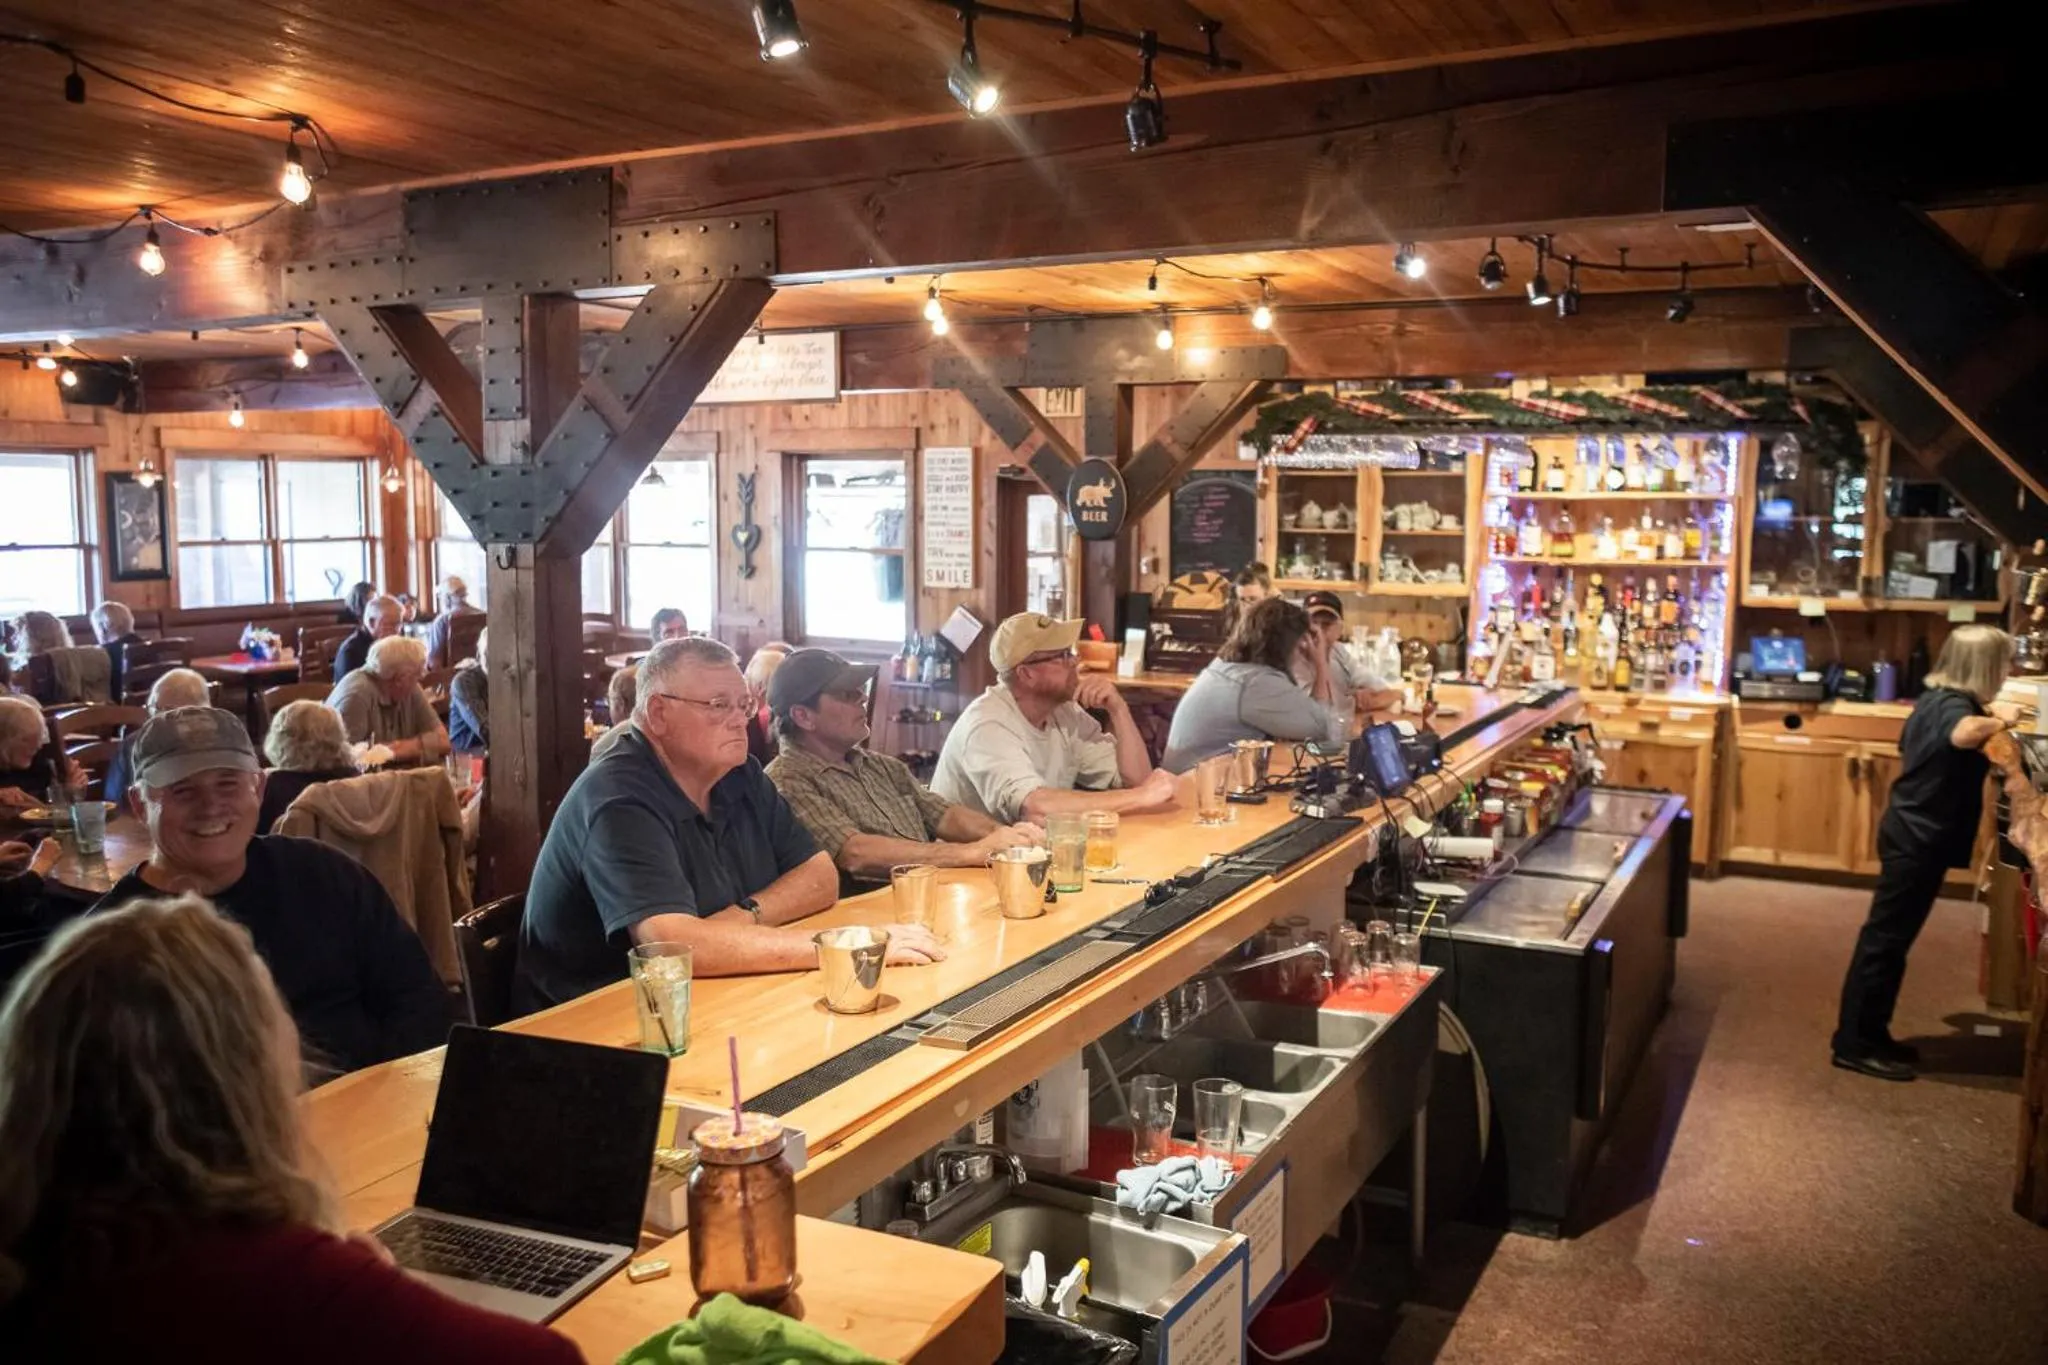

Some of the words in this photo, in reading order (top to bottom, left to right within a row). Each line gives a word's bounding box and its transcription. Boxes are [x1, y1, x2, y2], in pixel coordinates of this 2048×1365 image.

[1046, 387, 1076, 413] EXIT
[1082, 511, 1108, 522] BEER
[926, 568, 970, 584] SMILE
